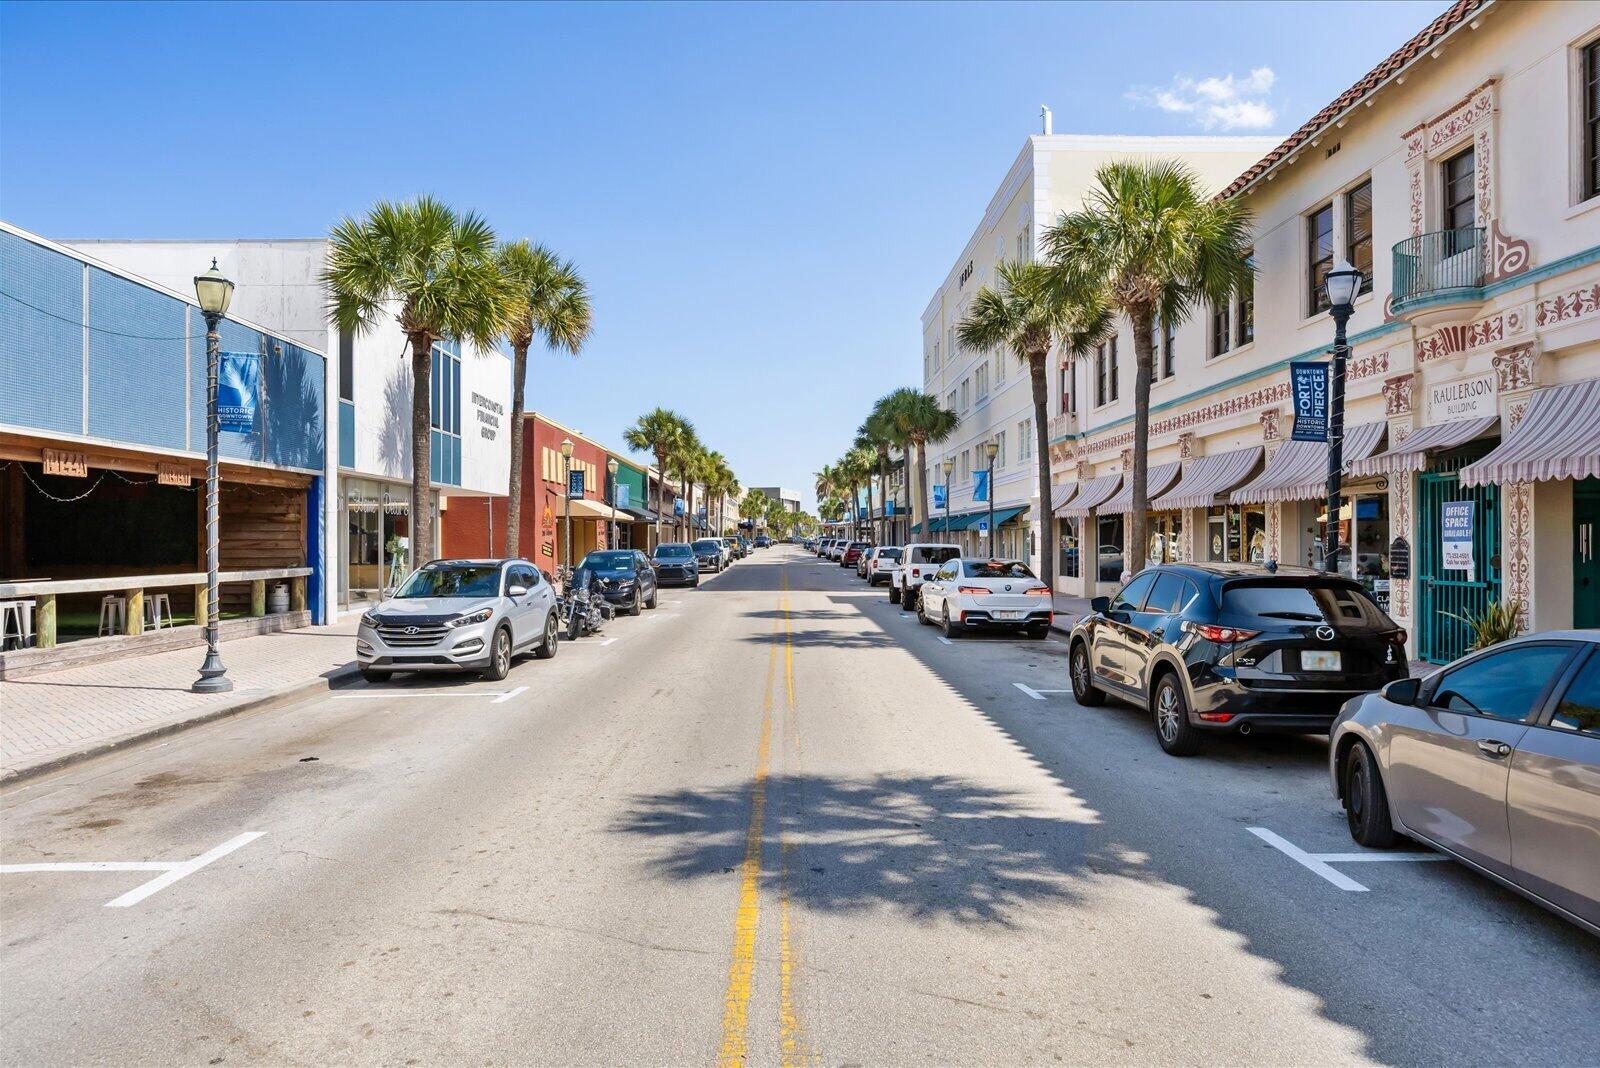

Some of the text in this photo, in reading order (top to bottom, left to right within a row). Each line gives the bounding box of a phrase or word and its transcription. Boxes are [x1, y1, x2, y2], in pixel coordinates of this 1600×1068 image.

[1313, 375, 1325, 417] PIERCE
[1433, 378, 1492, 404] RAULERSON
[1297, 383, 1311, 417] FORT
[217, 407, 254, 415] HISTORIC
[1447, 401, 1477, 415] BUILDING
[1445, 506, 1469, 517] OFFICE
[1445, 517, 1469, 528] SPACE
